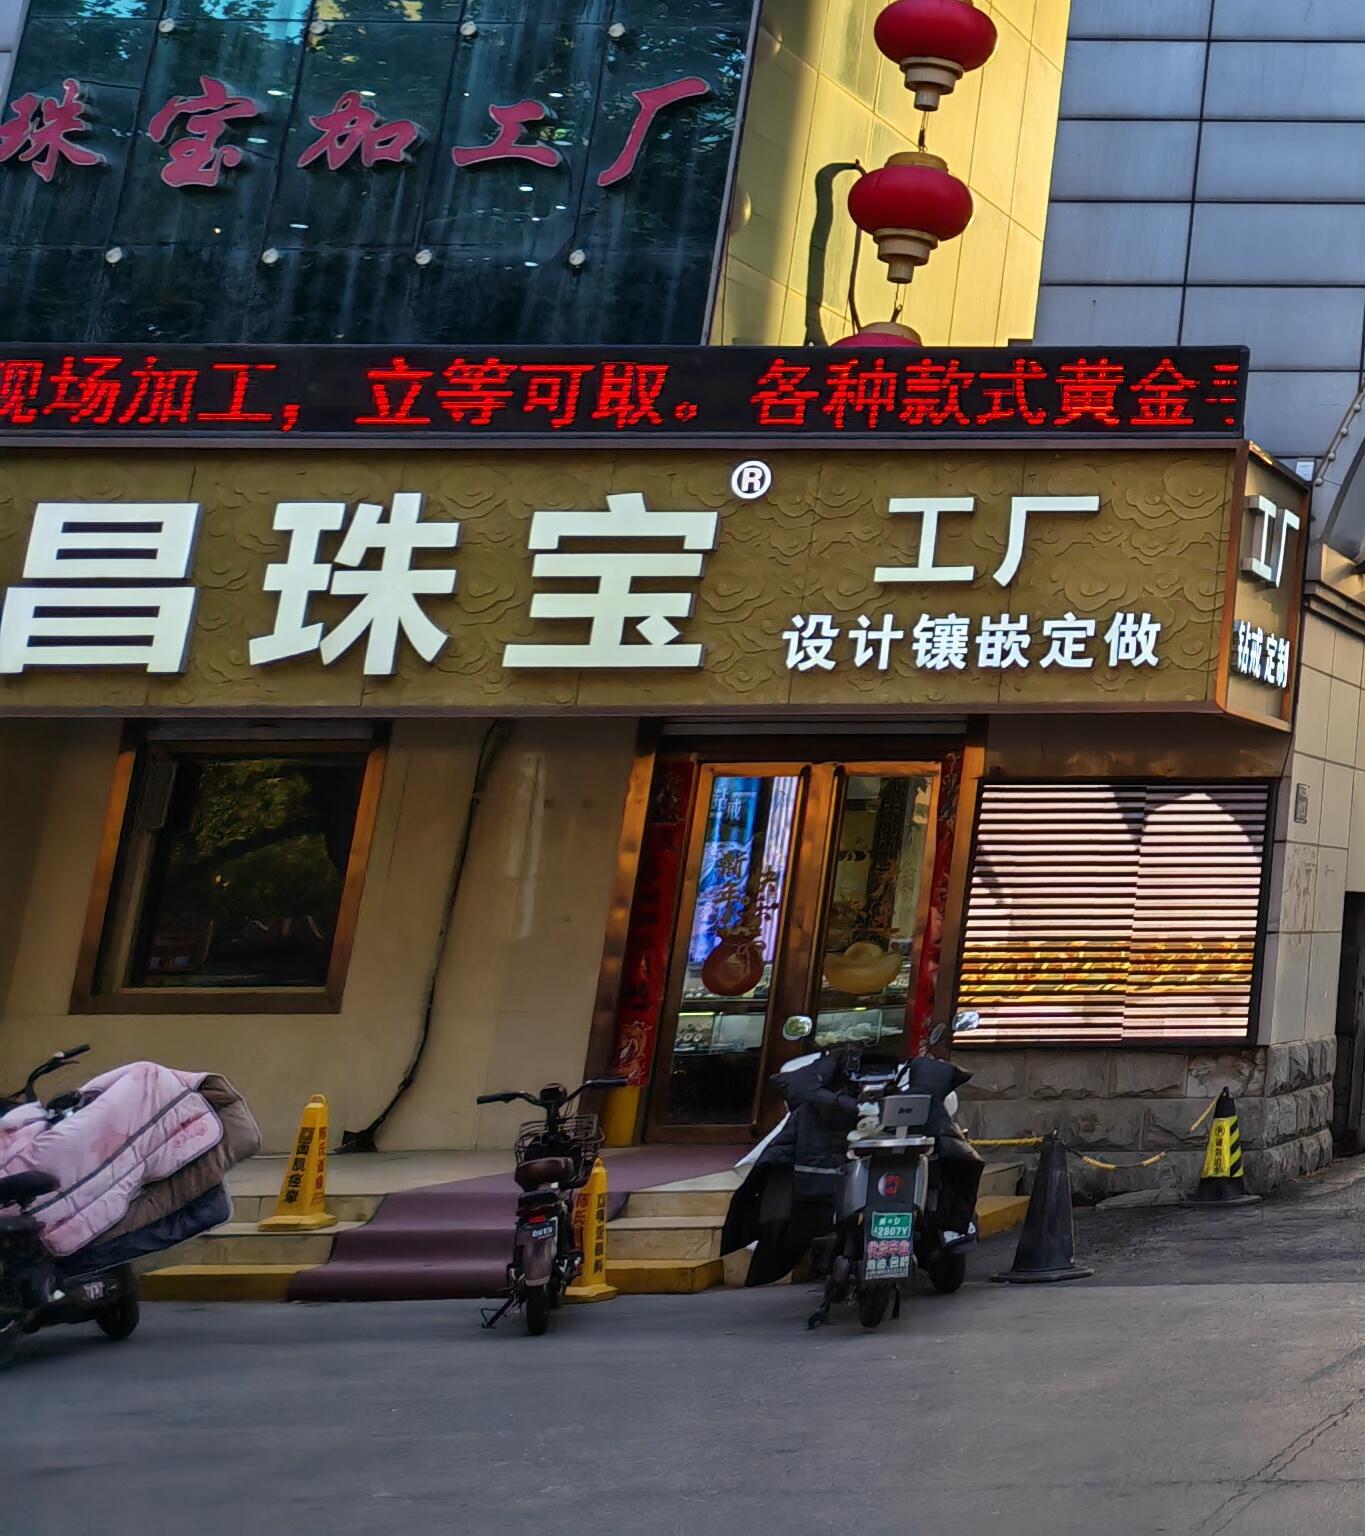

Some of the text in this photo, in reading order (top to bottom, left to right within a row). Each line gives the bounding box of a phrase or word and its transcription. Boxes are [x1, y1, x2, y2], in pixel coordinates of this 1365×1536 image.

[0, 77, 710, 189] 珠宝加工厂
[873, 496, 1099, 587] 工厂
[1243, 494, 1300, 589] 工厂
[782, 612, 1161, 671] 设计镶嵌定做
